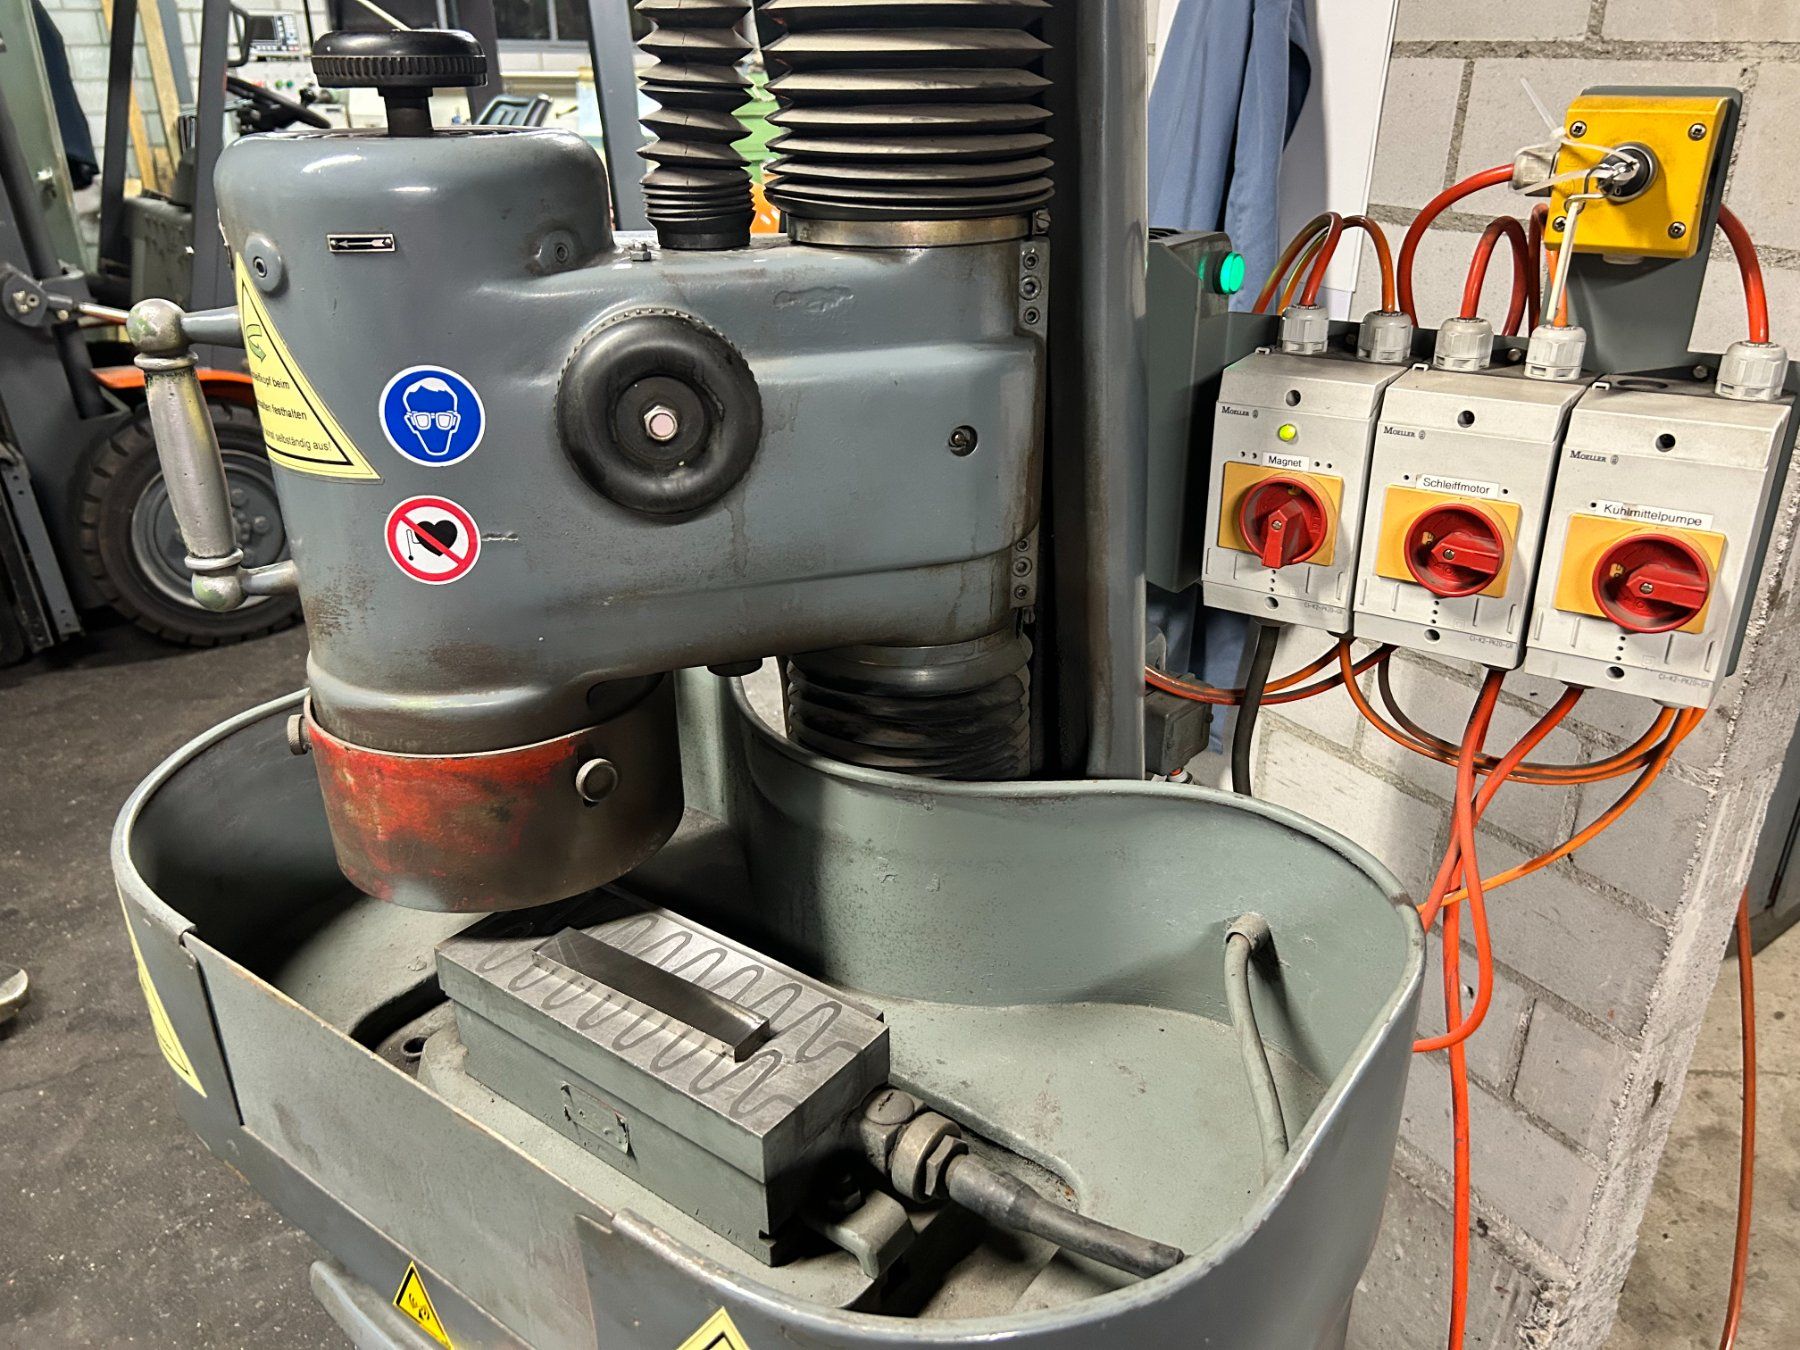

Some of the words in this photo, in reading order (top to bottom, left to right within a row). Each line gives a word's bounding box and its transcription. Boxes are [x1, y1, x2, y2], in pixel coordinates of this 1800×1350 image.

[272, 376, 290, 390] beim
[271, 404, 307, 420] festhalten
[275, 432, 311, 451] selbständig
[313, 441, 332, 452] aus!
[1268, 455, 1302, 468] Magnet
[1569, 450, 1607, 463] MOELLER
[1423, 477, 1490, 495] Schleiffmotor
